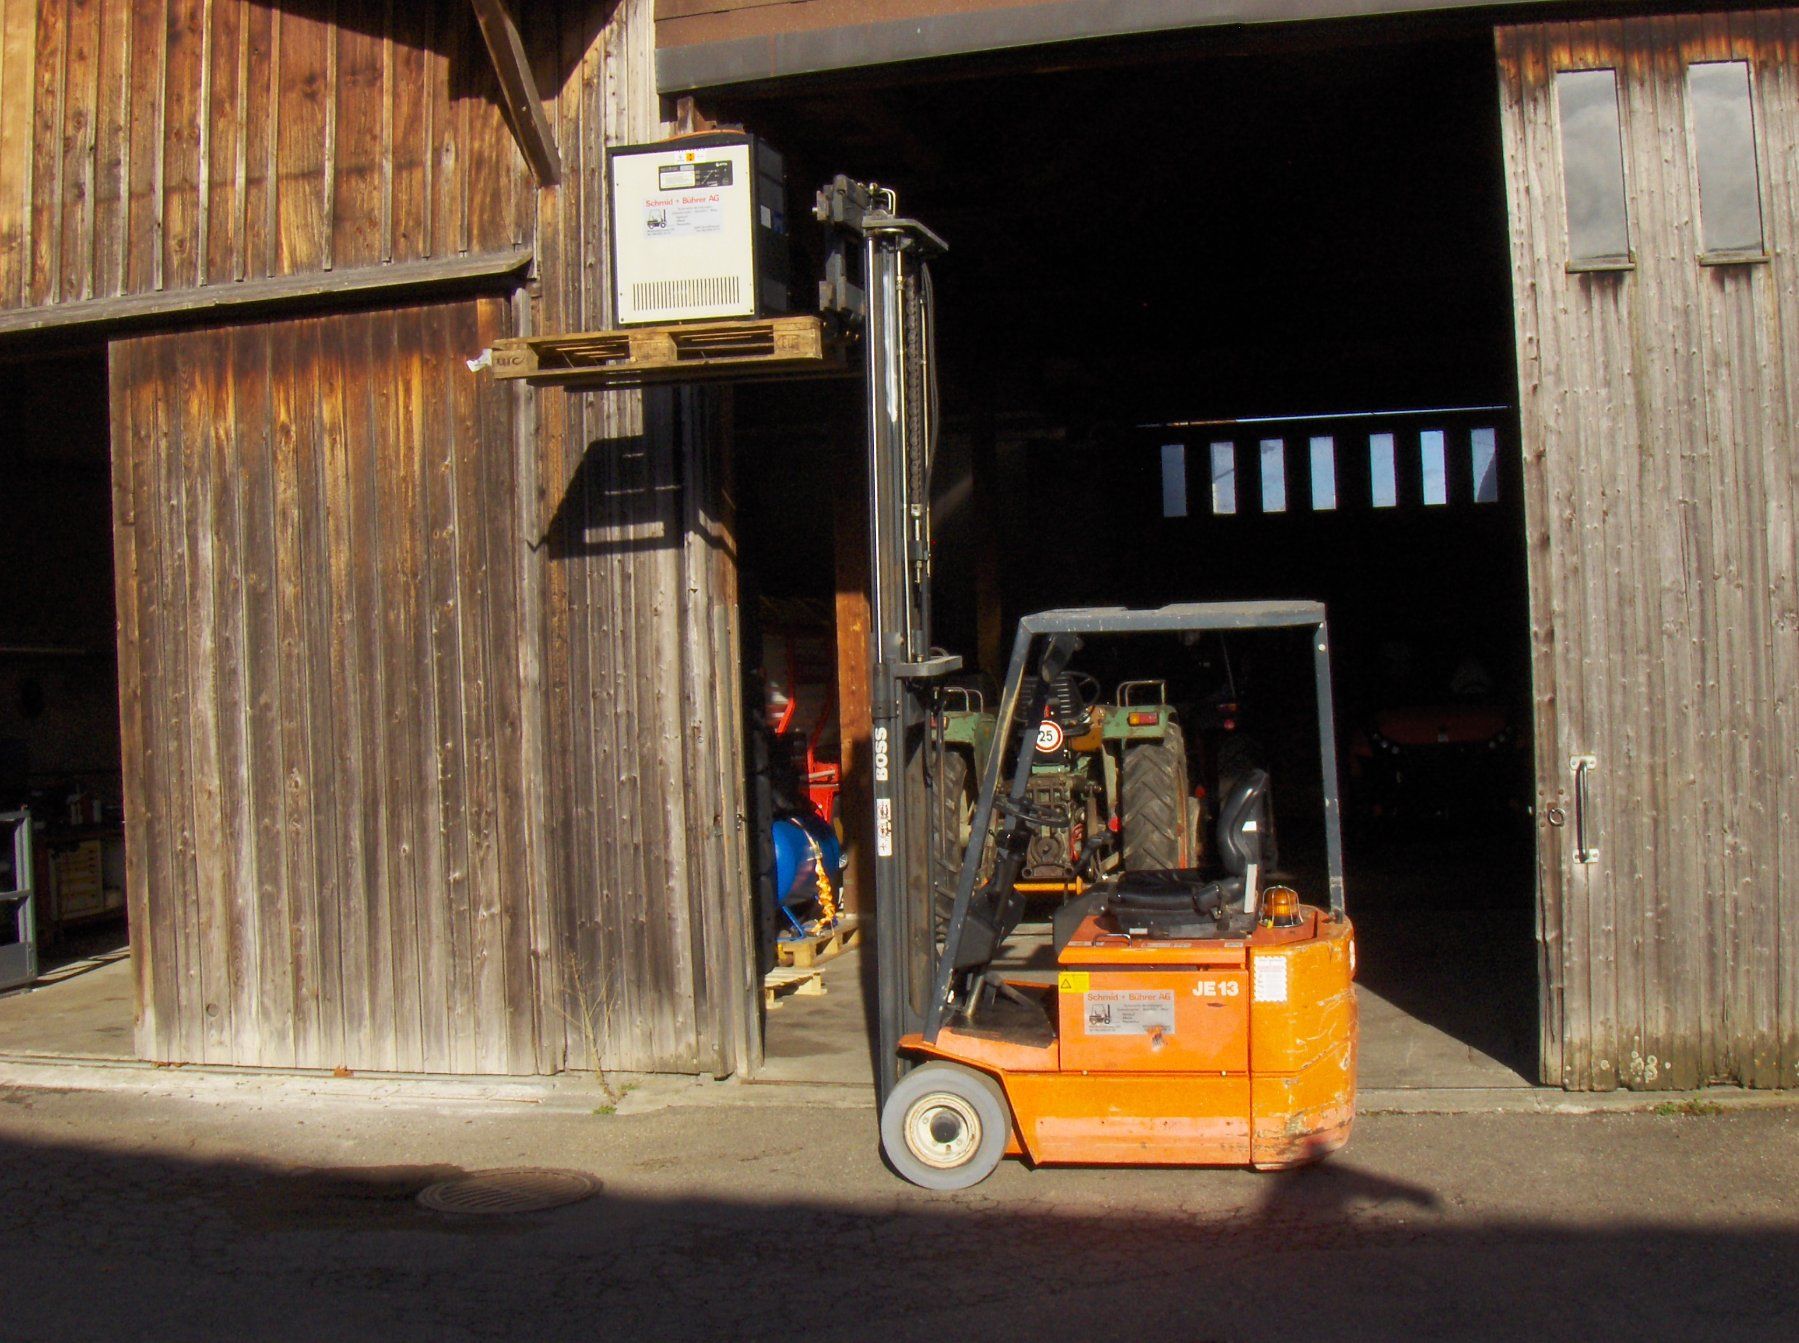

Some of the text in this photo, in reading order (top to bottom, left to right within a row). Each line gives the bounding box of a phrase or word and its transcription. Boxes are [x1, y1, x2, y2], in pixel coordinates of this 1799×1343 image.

[646, 199, 673, 207] Schmid
[708, 194, 720, 202] AG
[1039, 730, 1053, 742] 25
[874, 726, 889, 781] BOSS
[1087, 993, 1119, 1001] Schmid
[1159, 993, 1171, 1001] AG
